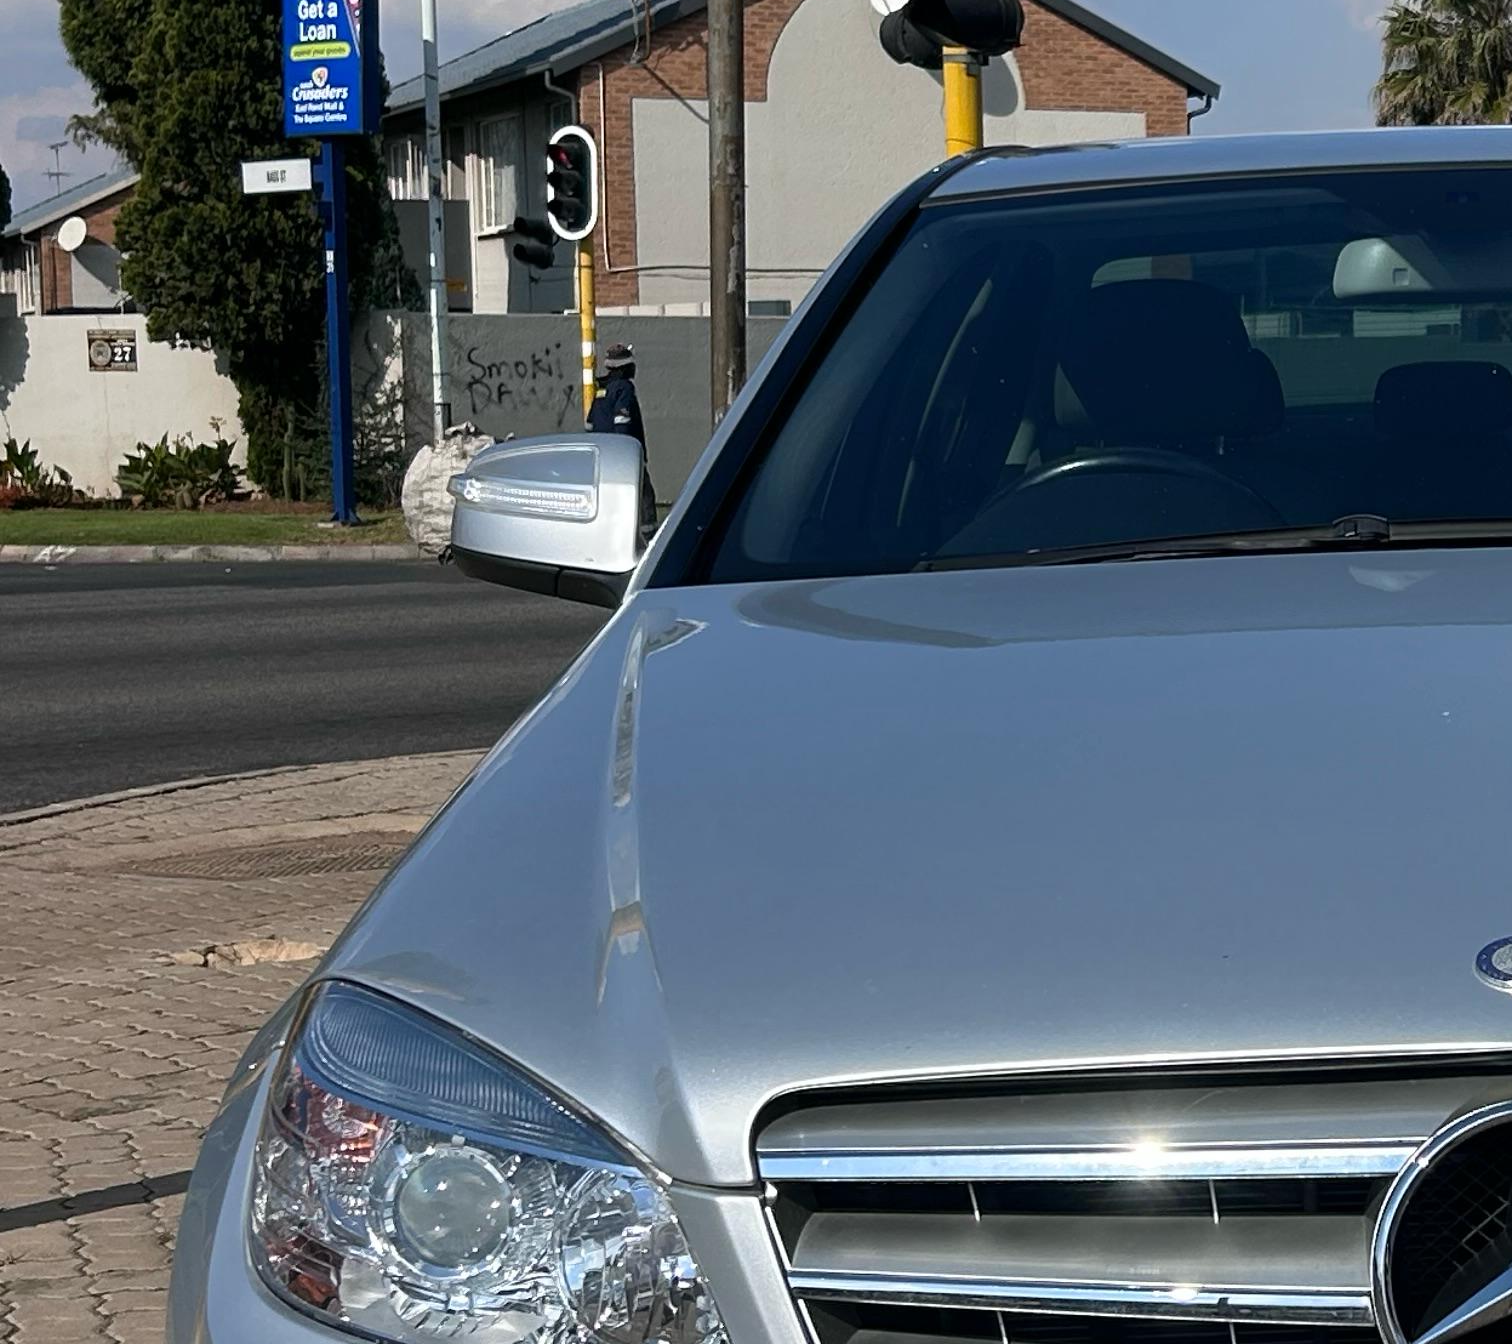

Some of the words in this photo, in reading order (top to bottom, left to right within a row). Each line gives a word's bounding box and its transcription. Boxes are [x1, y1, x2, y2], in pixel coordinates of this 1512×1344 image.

[298, 0, 324, 20] Get
[327, 1, 338, 18] a
[299, 21, 337, 42] Loan
[292, 84, 349, 101] Crusaders
[114, 346, 131, 362] 27
